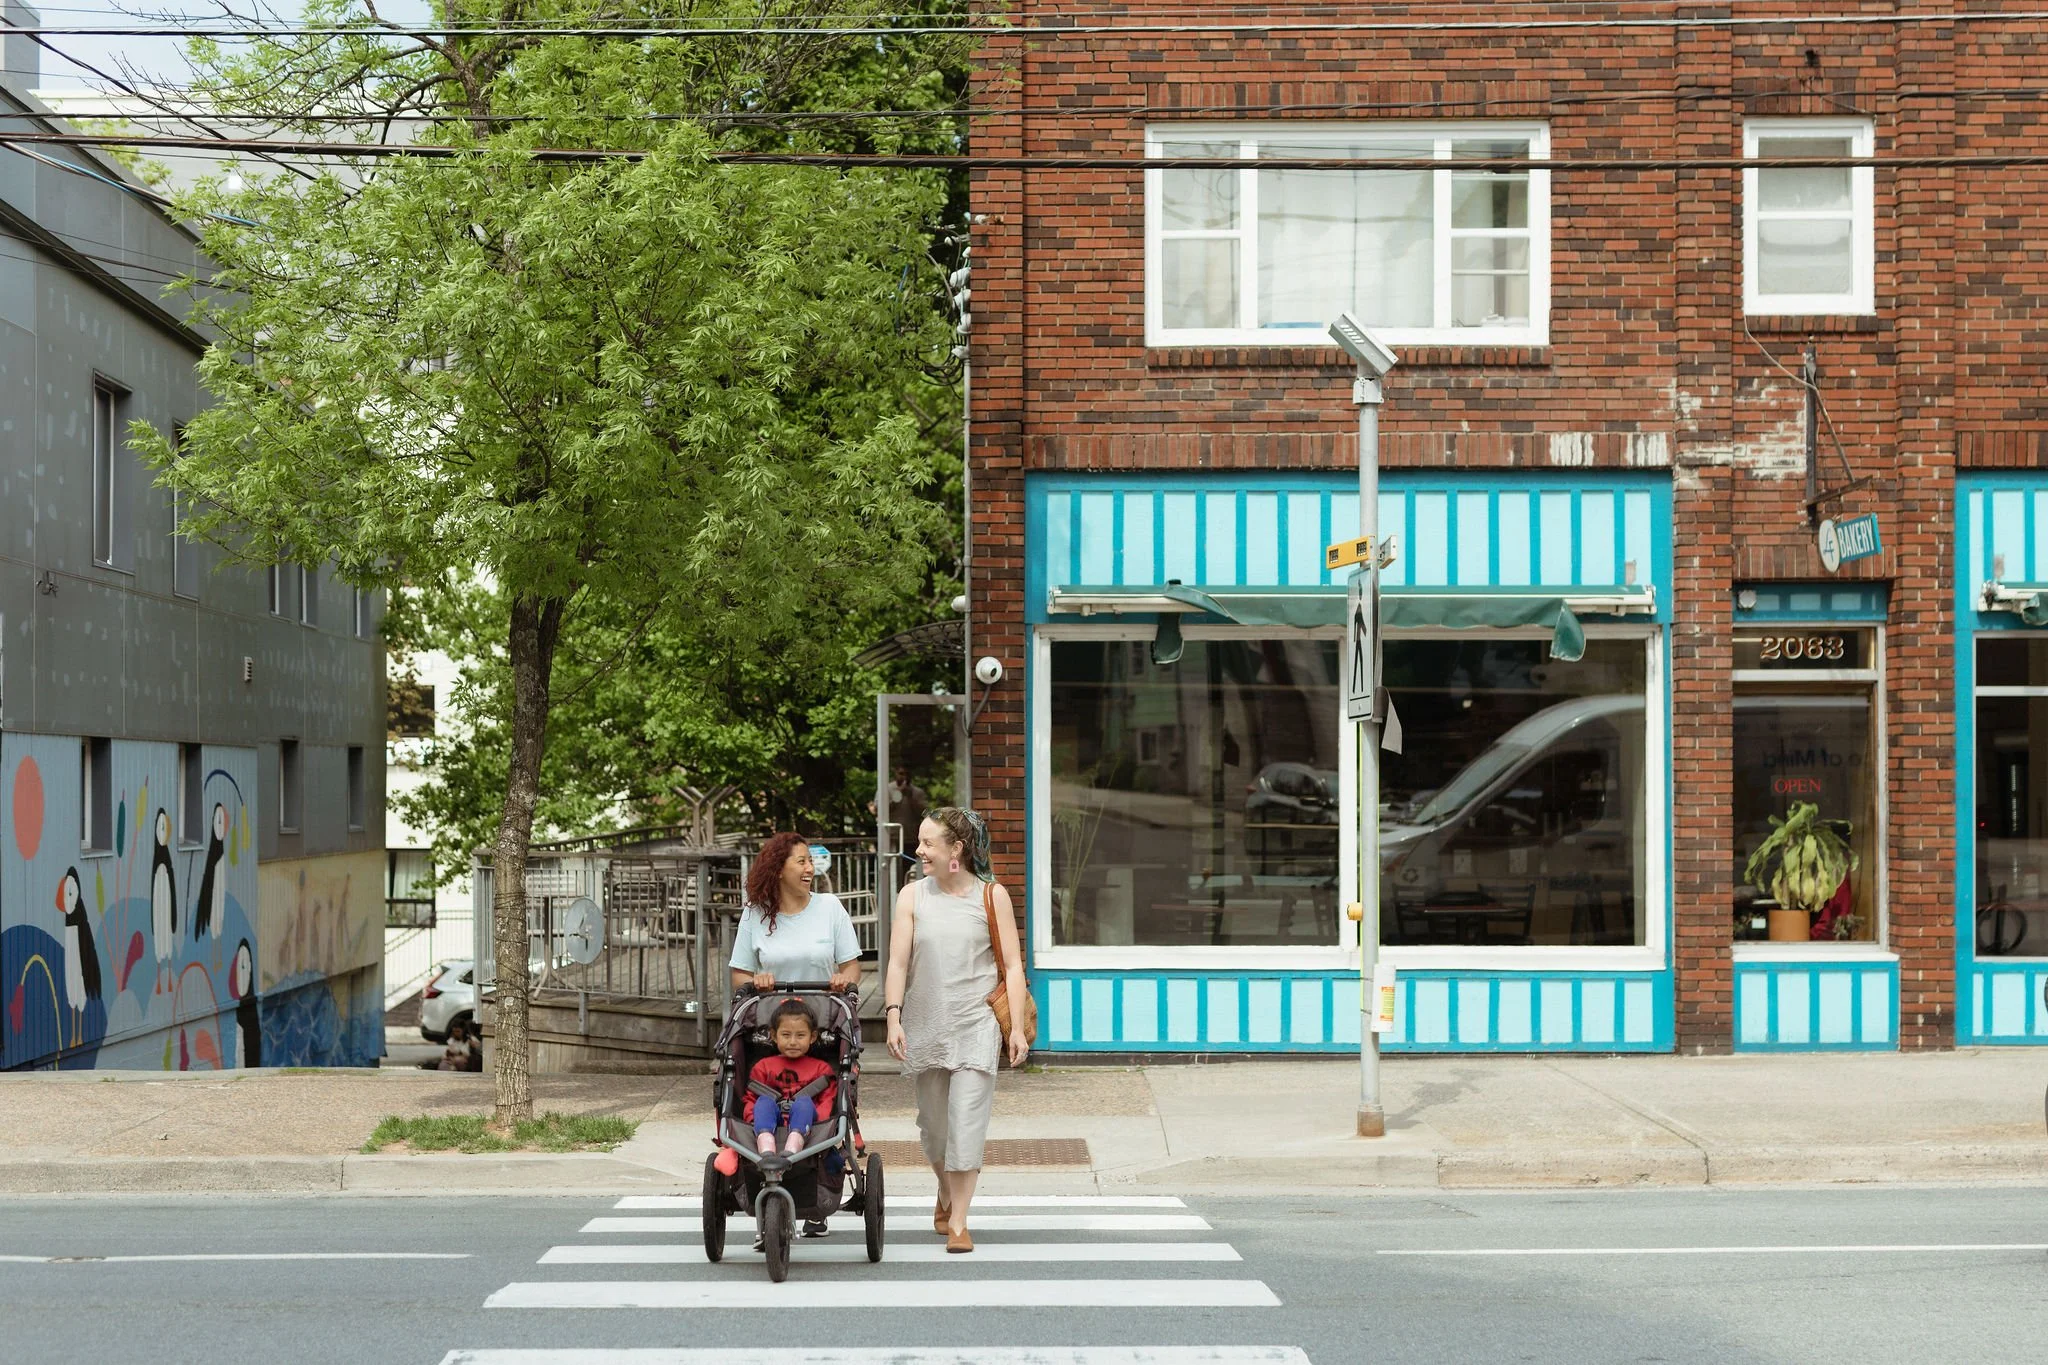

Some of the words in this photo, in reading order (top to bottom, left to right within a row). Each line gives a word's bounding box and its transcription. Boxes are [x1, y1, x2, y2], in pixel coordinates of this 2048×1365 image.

[1837, 519, 1874, 559] BAKERY
[1760, 635, 1844, 659] 2063
[1773, 778, 1821, 793] OPEN
